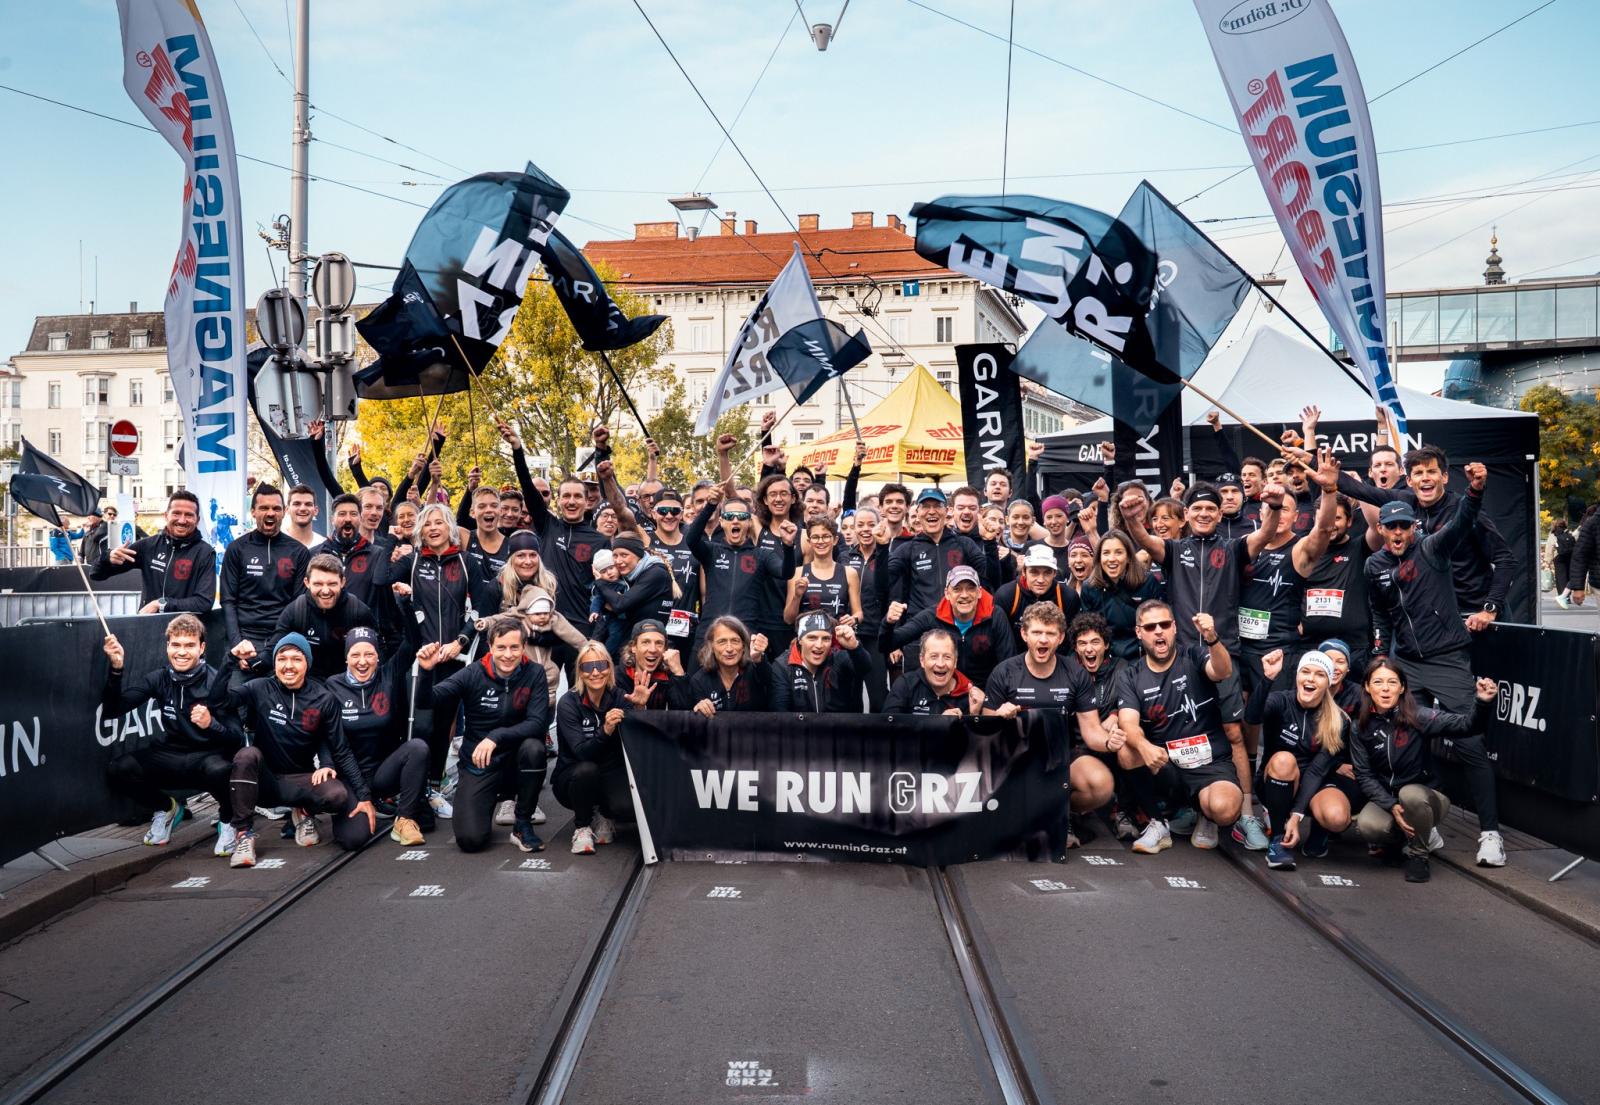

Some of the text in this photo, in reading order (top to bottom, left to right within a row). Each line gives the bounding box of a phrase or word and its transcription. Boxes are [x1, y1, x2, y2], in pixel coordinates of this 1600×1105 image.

[906, 282, 915, 295] T
[973, 352, 1008, 471] GARM
[1315, 432, 1423, 454] GARN
[802, 448, 839, 465] antenne
[906, 444, 957, 462] antenne
[1078, 444, 1104, 461] GAR
[1240, 616, 1259, 626] 12676
[1496, 679, 1546, 732] GRZ.
[1180, 746, 1199, 756] 6880
[690, 769, 1000, 814] WE RUN GRZ.
[784, 840, 907, 855] www.runninGraz.at
[727, 1069, 773, 1077] RUN
[728, 1061, 760, 1069] WE
[726, 1077, 779, 1087] GRZ.
